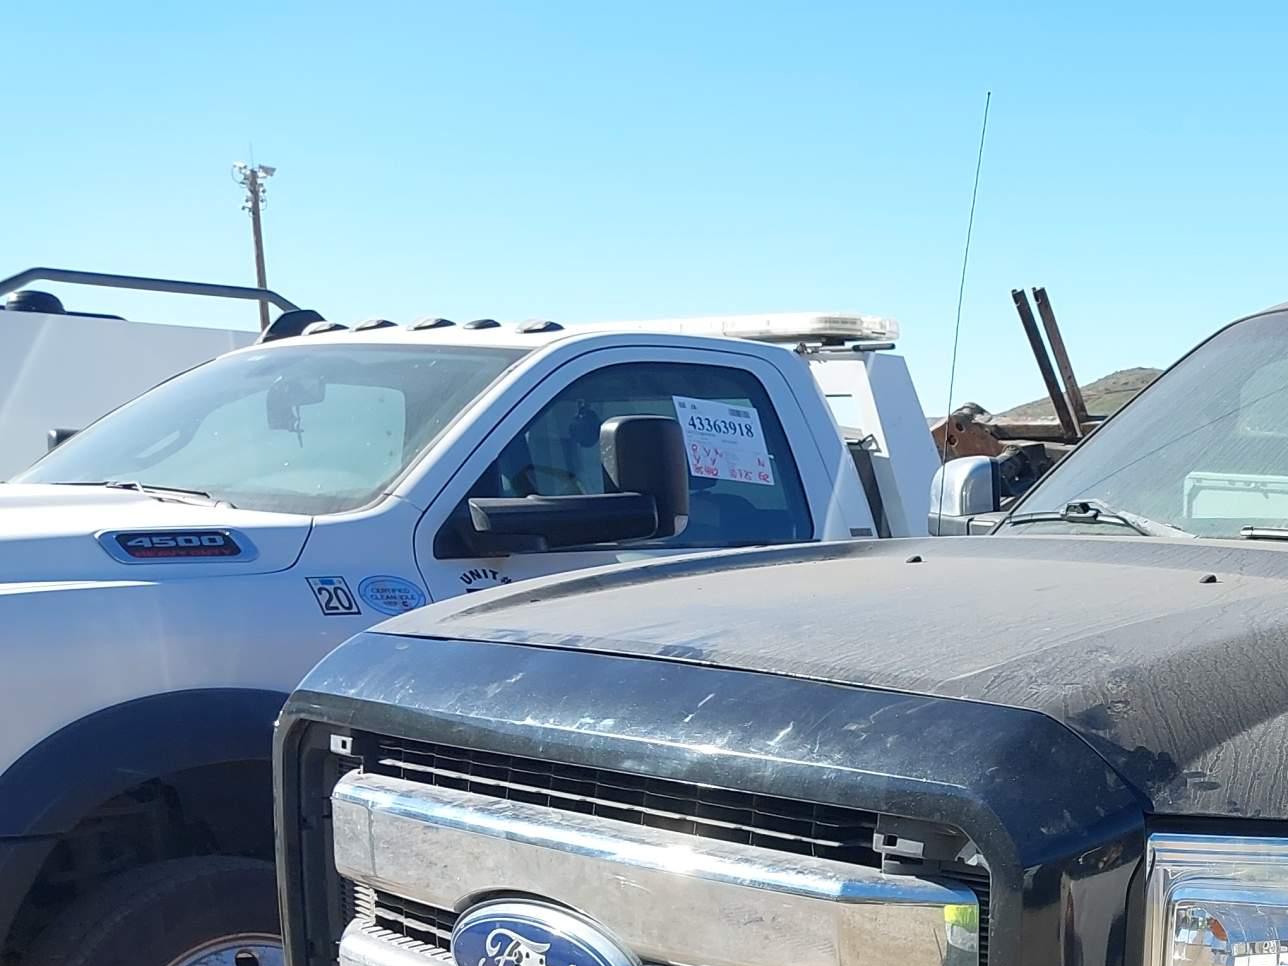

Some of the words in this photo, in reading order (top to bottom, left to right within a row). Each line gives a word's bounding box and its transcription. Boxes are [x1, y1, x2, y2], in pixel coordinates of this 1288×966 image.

[688, 415, 754, 438] 43363918
[127, 535, 225, 548] 4500
[460, 568, 499, 585] UNIT
[317, 586, 353, 611] 20
